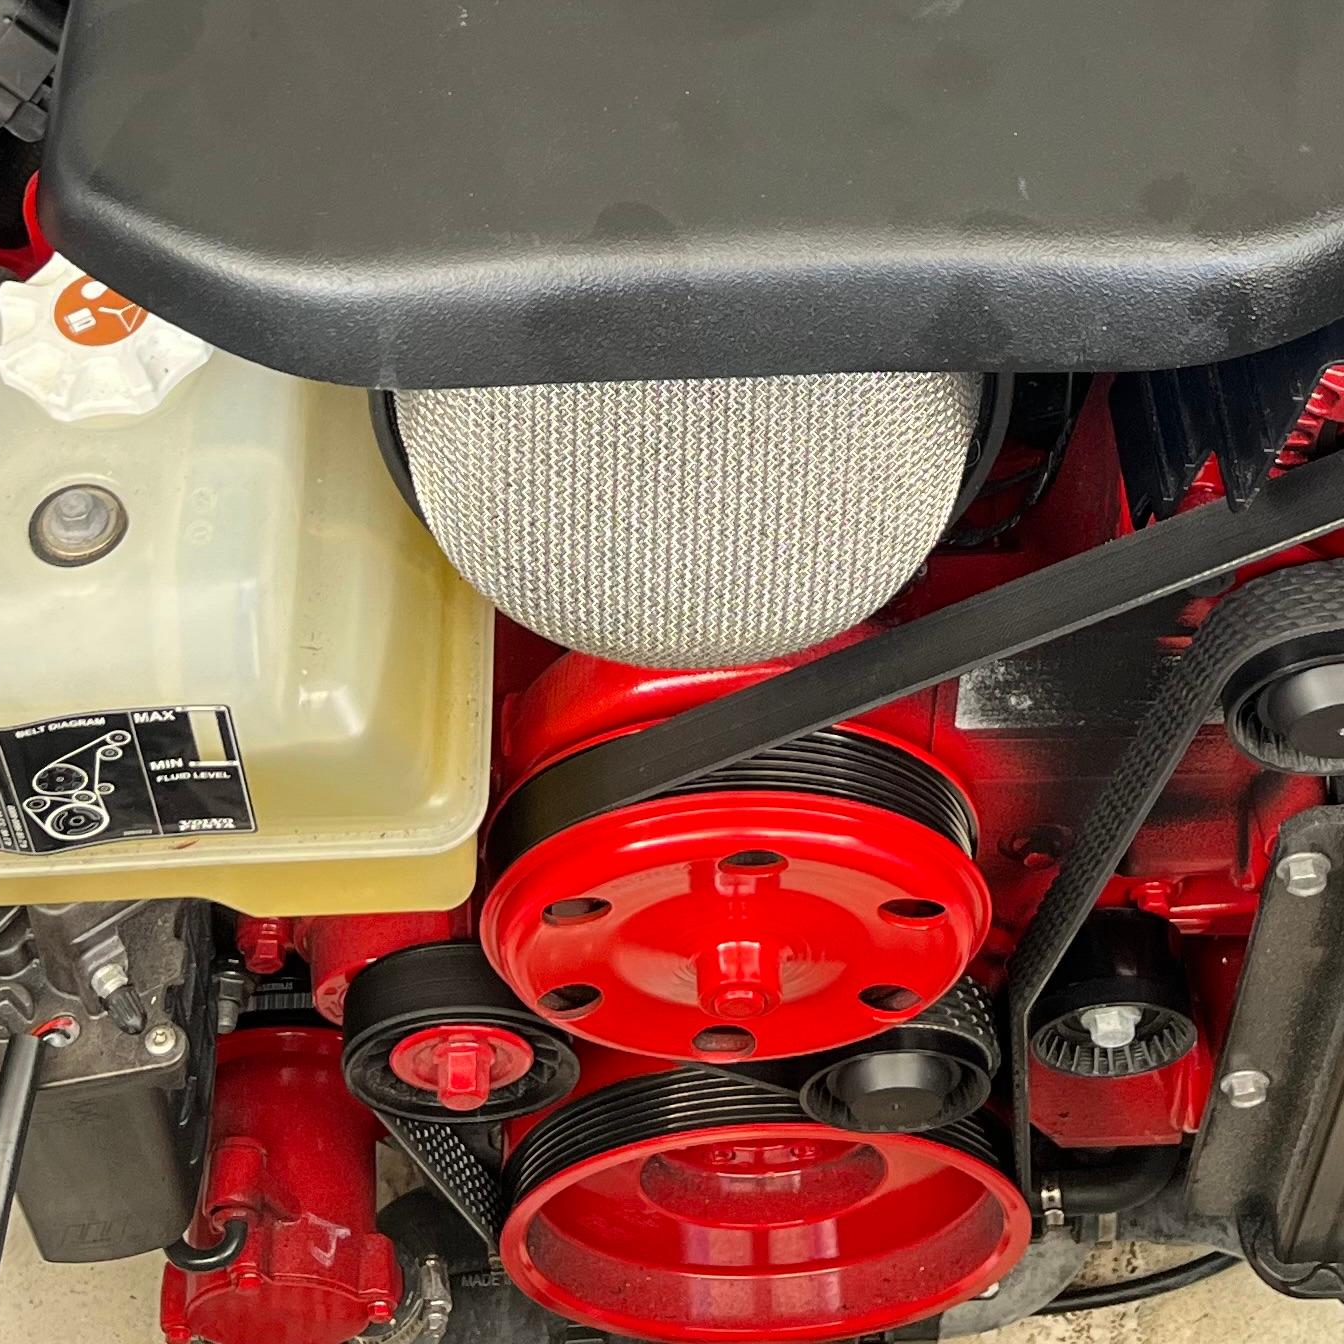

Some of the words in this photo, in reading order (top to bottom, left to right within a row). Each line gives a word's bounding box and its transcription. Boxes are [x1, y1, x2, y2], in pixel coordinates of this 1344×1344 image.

[133, 709, 176, 724] MAX
[15, 725, 47, 739] BELT
[48, 716, 106, 733] DIAGRAM
[149, 757, 184, 772] MIN
[156, 771, 192, 783] FLUID
[193, 770, 232, 780] LEVEL
